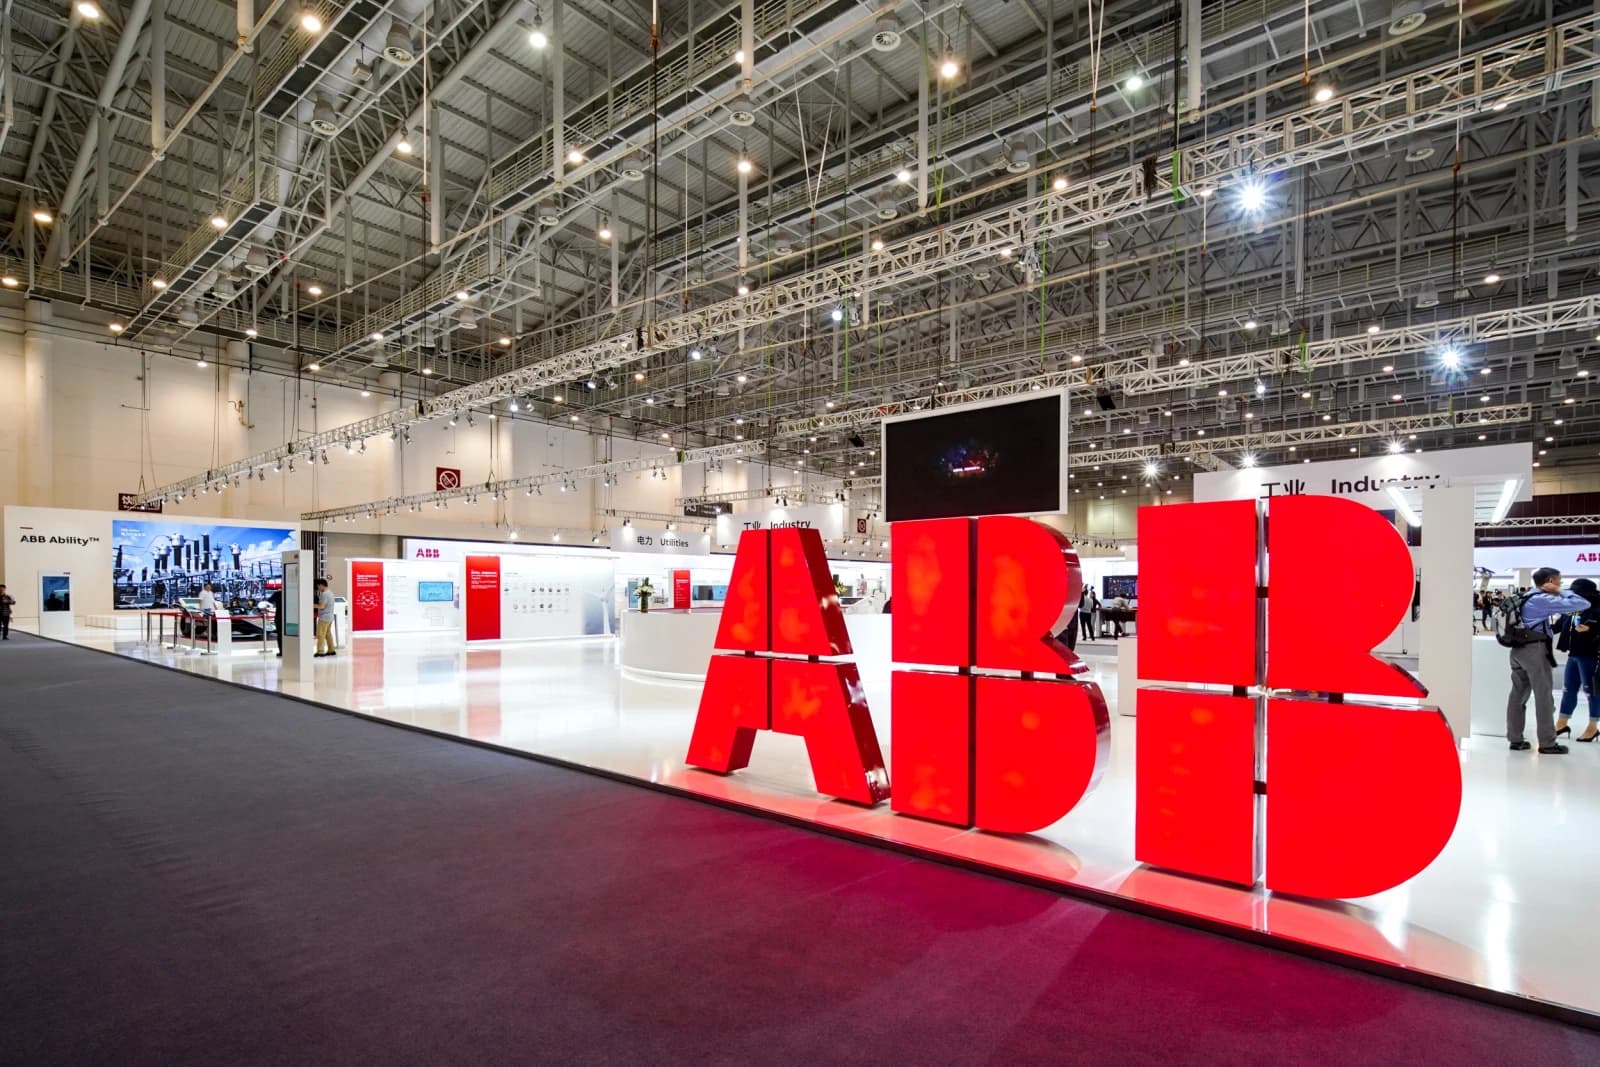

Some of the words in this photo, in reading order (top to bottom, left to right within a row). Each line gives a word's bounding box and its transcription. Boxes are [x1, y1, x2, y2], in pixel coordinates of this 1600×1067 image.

[20, 535, 47, 544] ABB
[637, 536, 653, 546] 电力
[660, 538, 689, 548] Utilities
[416, 548, 440, 558] ABB
[1576, 552, 1600, 562] AB
[685, 495, 1462, 899] ABB
